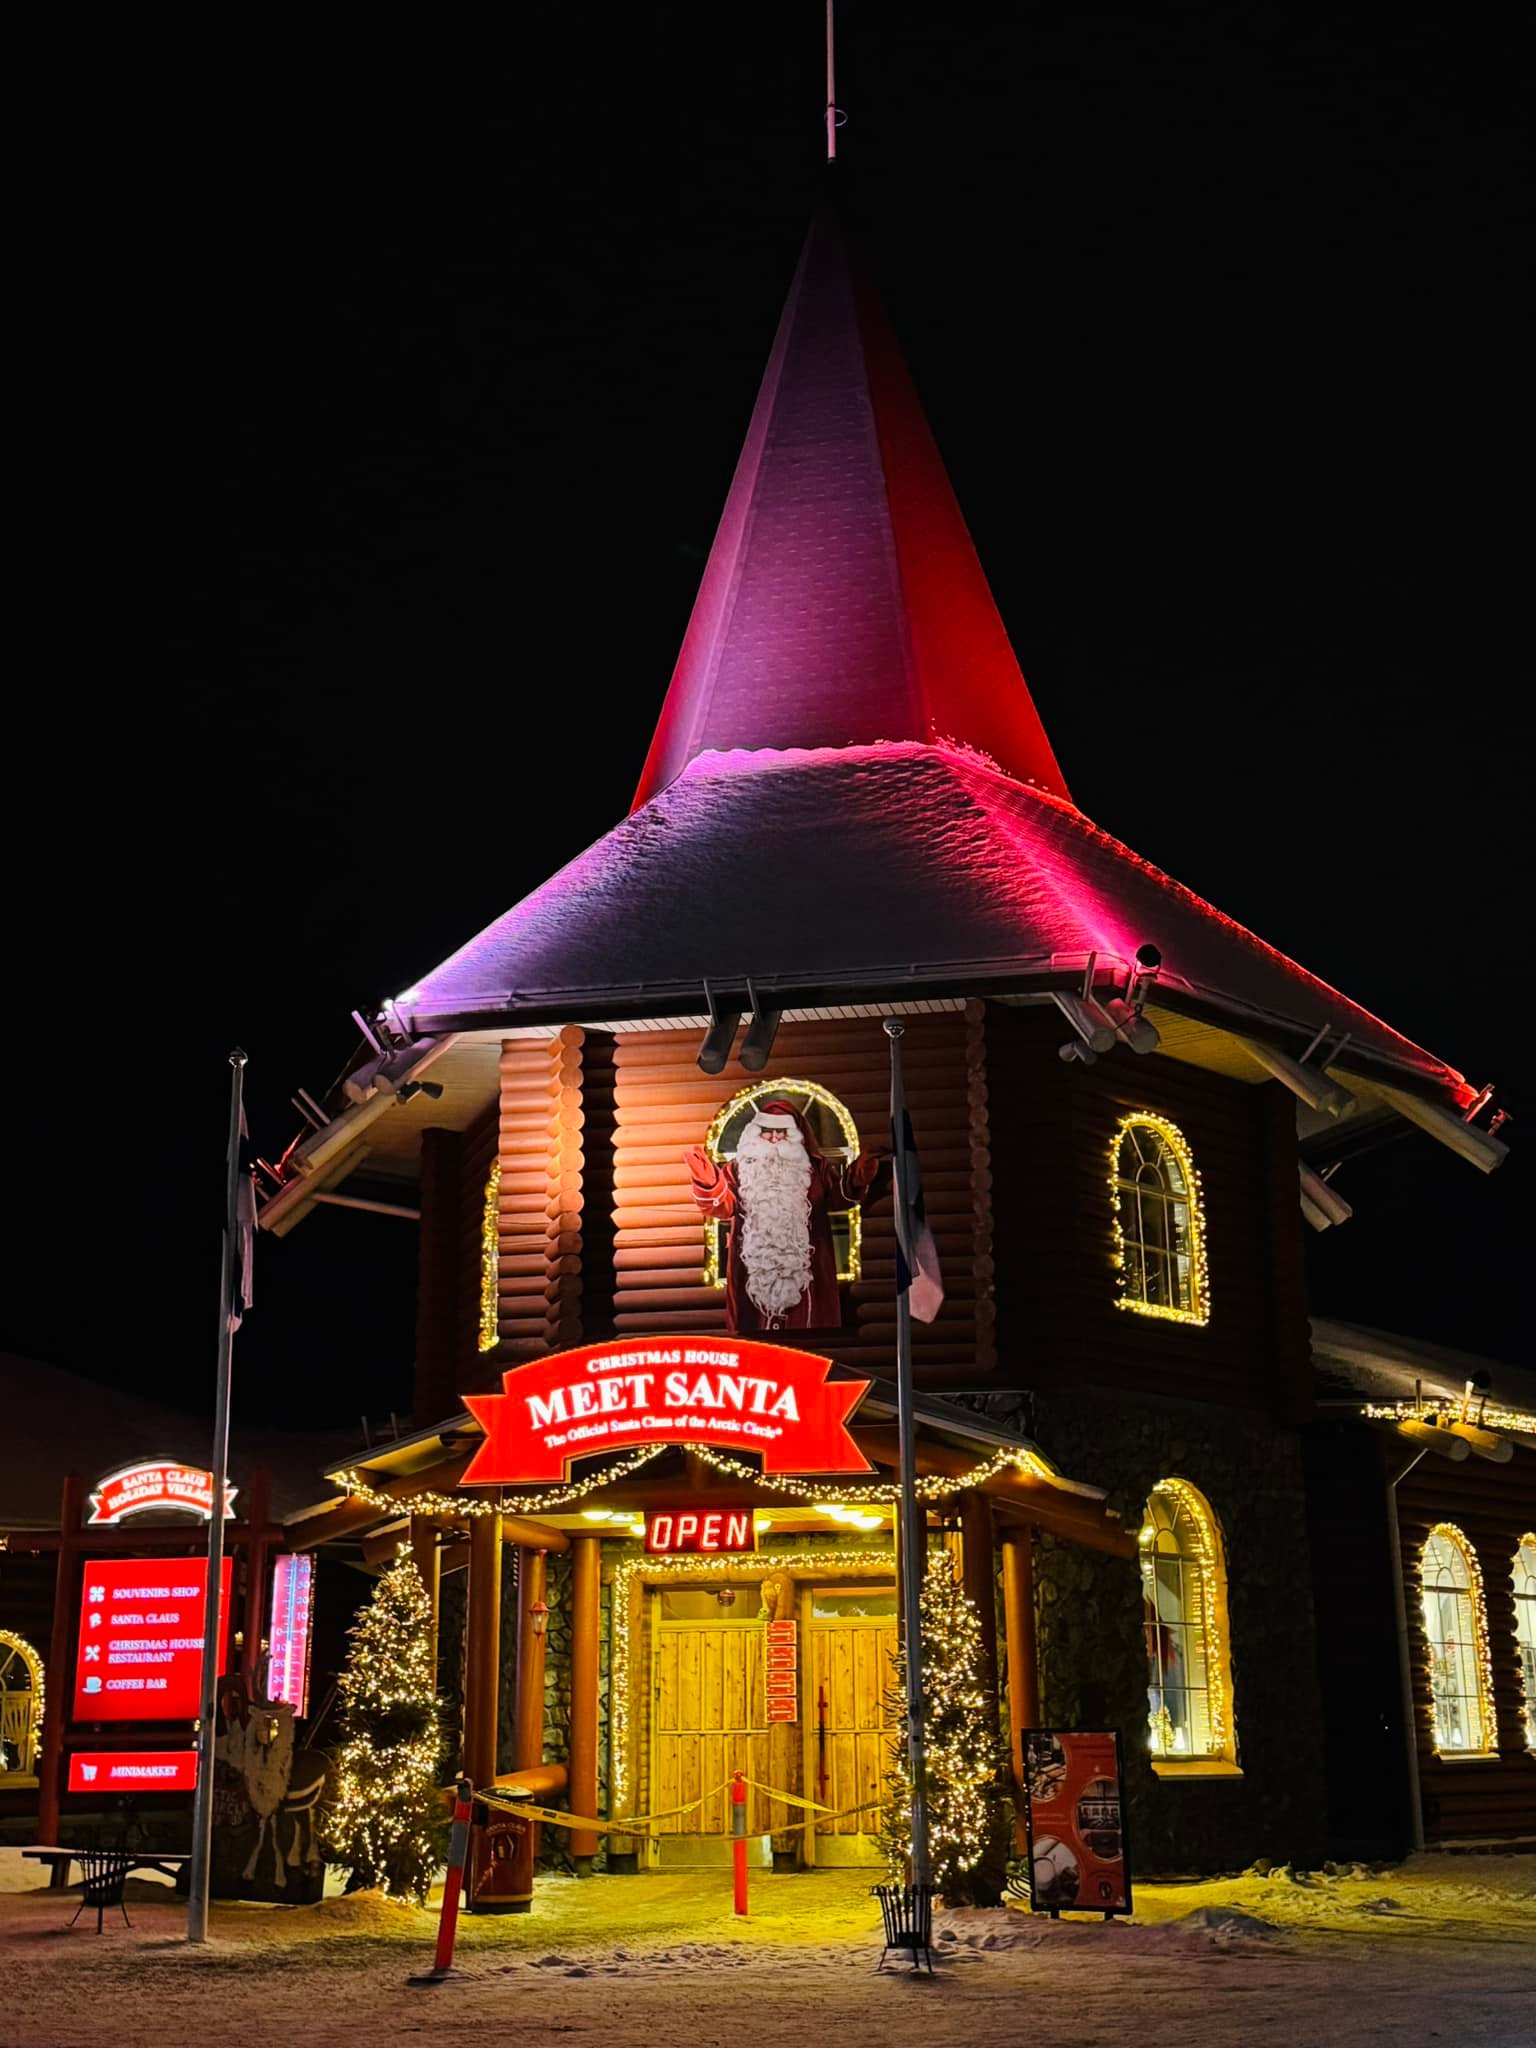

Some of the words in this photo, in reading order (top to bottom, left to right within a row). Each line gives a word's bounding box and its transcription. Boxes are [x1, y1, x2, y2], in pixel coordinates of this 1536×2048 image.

[586, 1350, 681, 1374] CHRISTMAS
[684, 1350, 739, 1368] HOUSE
[526, 1373, 655, 1431] MEET
[664, 1371, 801, 1422] SANTA
[543, 1434, 567, 1448] The
[567, 1421, 609, 1441] Official
[610, 1419, 641, 1432] Santa
[641, 1415, 673, 1429] Claus
[674, 1414, 689, 1428] of
[688, 1416, 706, 1428] the
[707, 1416, 742, 1432] Arctic
[121, 1471, 163, 1490] SANTA
[165, 1470, 207, 1488] CLAUS
[107, 1483, 164, 1509] HOLIDAY
[167, 1483, 213, 1503] VILLAG
[652, 1515, 748, 1549] OPEN
[112, 1588, 170, 1599] SOUVENIRS
[171, 1586, 200, 1597] SHOP
[110, 1614, 144, 1625] SANTA
[145, 1613, 180, 1624] CLAUS
[108, 1640, 168, 1651] CHRISTMAS
[169, 1638, 205, 1649] HOUSE
[107, 1652, 175, 1664] RESTAURANT
[105, 1679, 144, 1690] COFFEE
[145, 1679, 167, 1689] BAR
[110, 1765, 179, 1778] MINIMARKET
